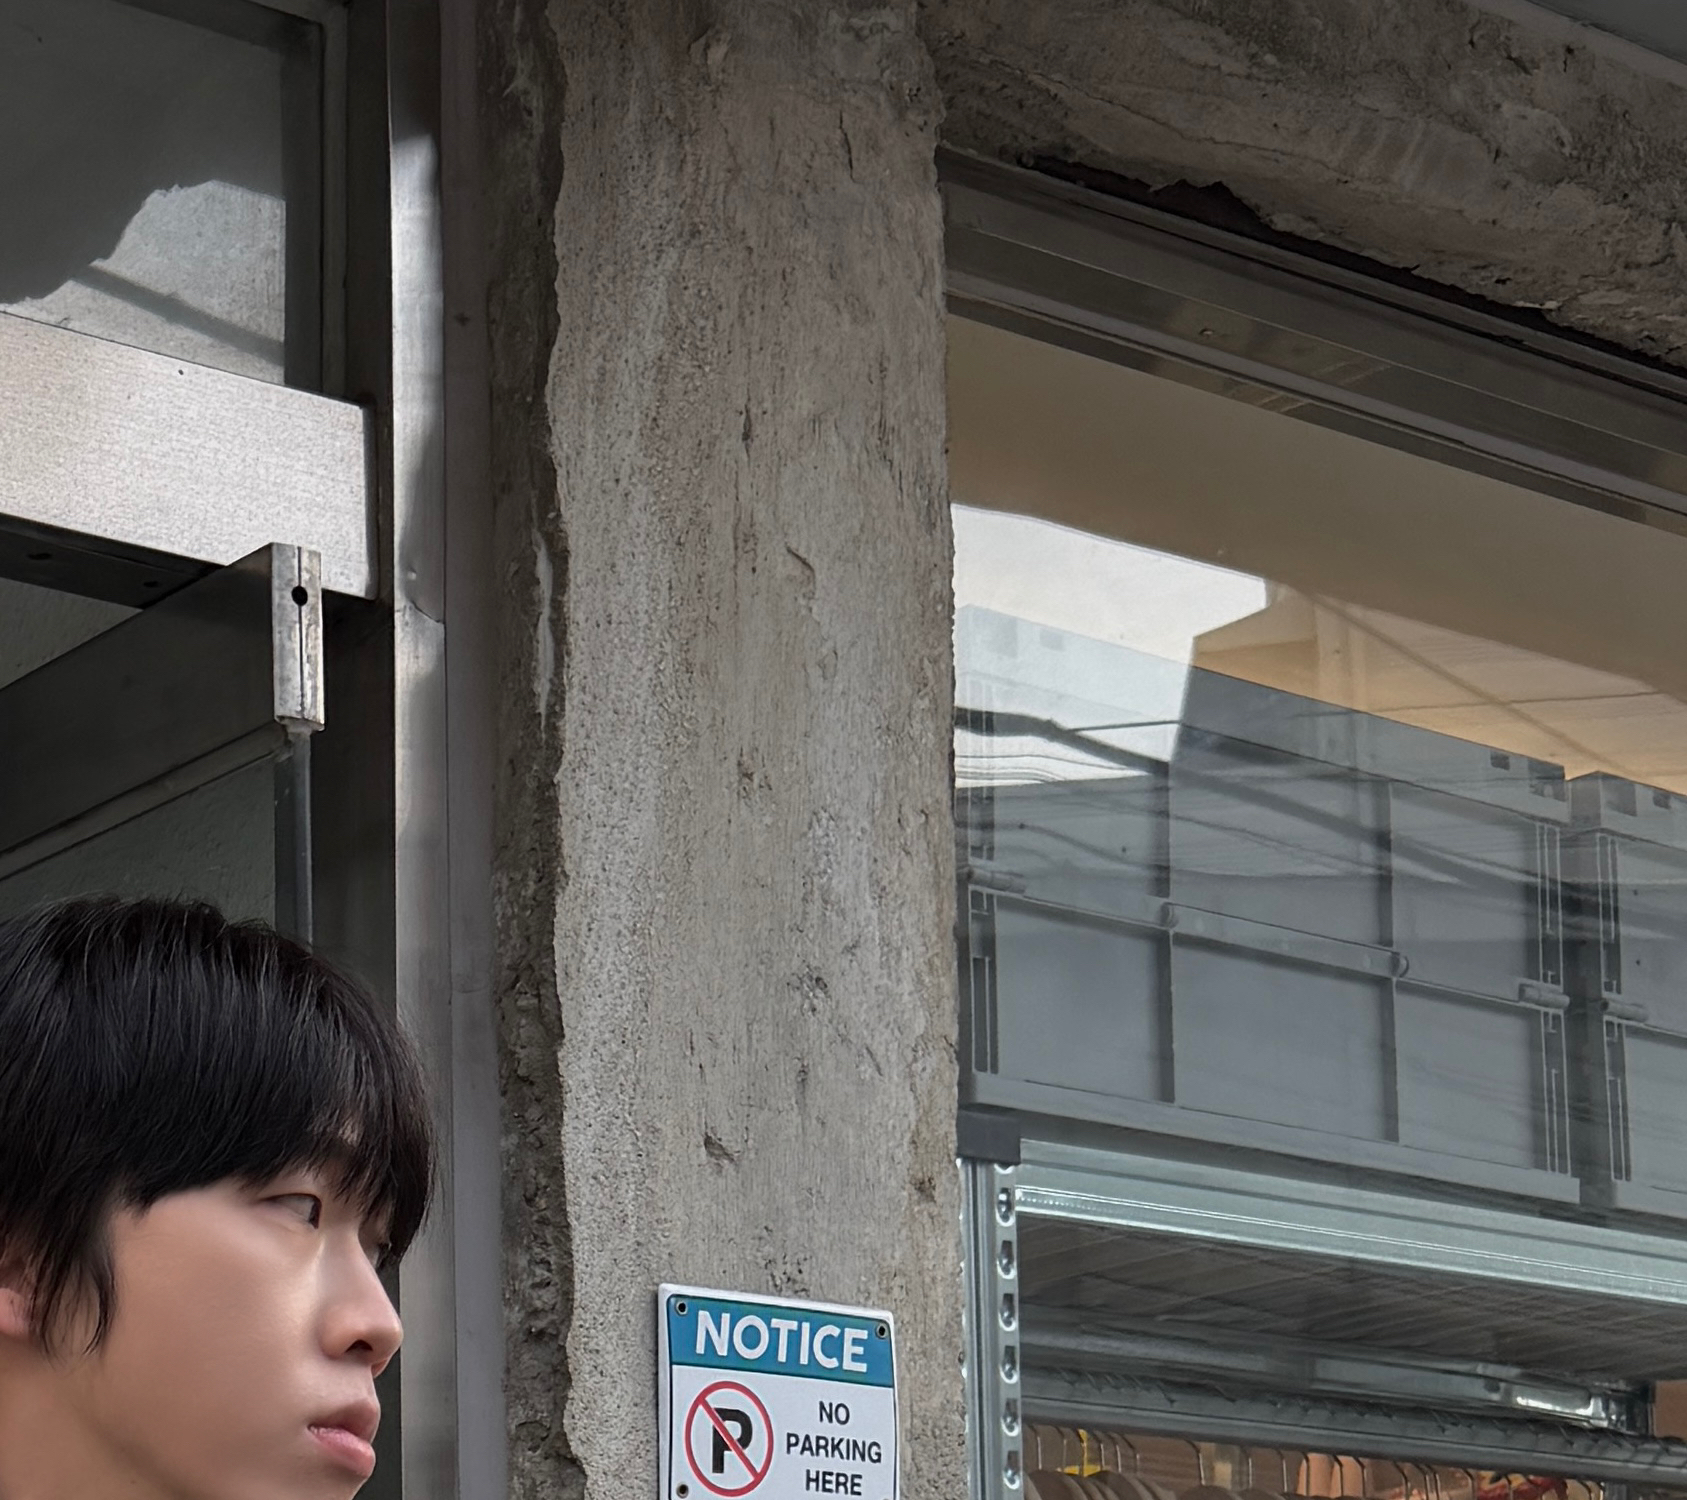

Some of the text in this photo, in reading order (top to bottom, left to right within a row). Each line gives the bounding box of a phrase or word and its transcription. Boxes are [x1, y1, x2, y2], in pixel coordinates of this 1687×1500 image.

[695, 1310, 869, 1373] NOTICE
[818, 1400, 850, 1426] NO
[786, 1432, 883, 1464] PARKING
[805, 1469, 863, 1497] HERE
